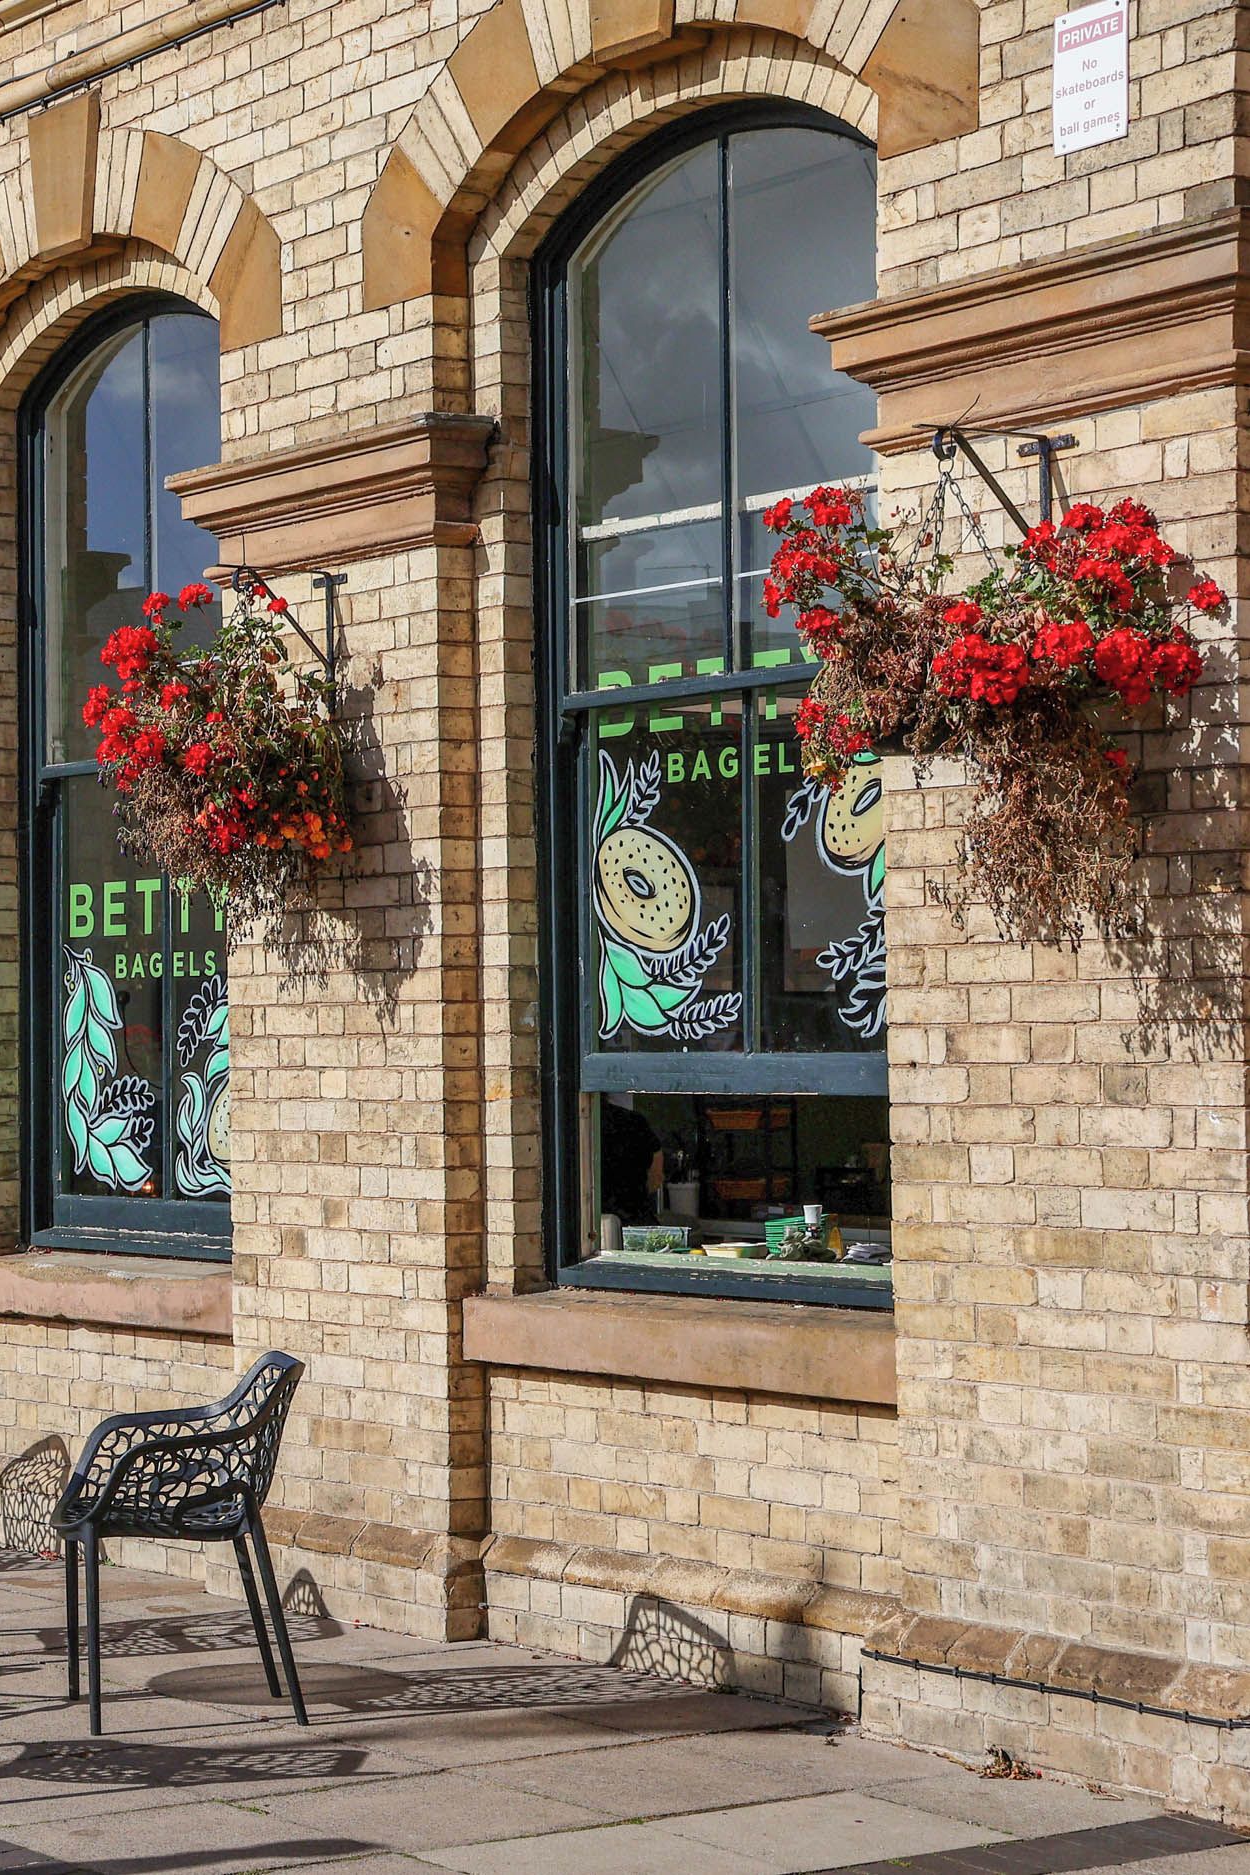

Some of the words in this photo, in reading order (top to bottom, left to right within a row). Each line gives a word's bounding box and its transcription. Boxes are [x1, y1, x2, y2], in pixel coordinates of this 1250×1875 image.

[1061, 16, 1119, 49] PRIVATE
[1082, 58, 1098, 73] No
[1055, 69, 1124, 99] skateboards
[1084, 99, 1096, 111] or
[1060, 121, 1080, 138] ball
[1083, 111, 1120, 134] games
[599, 646, 819, 738] BETT
[69, 877, 229, 938] BETTY
[115, 949, 217, 980] BAGELS
